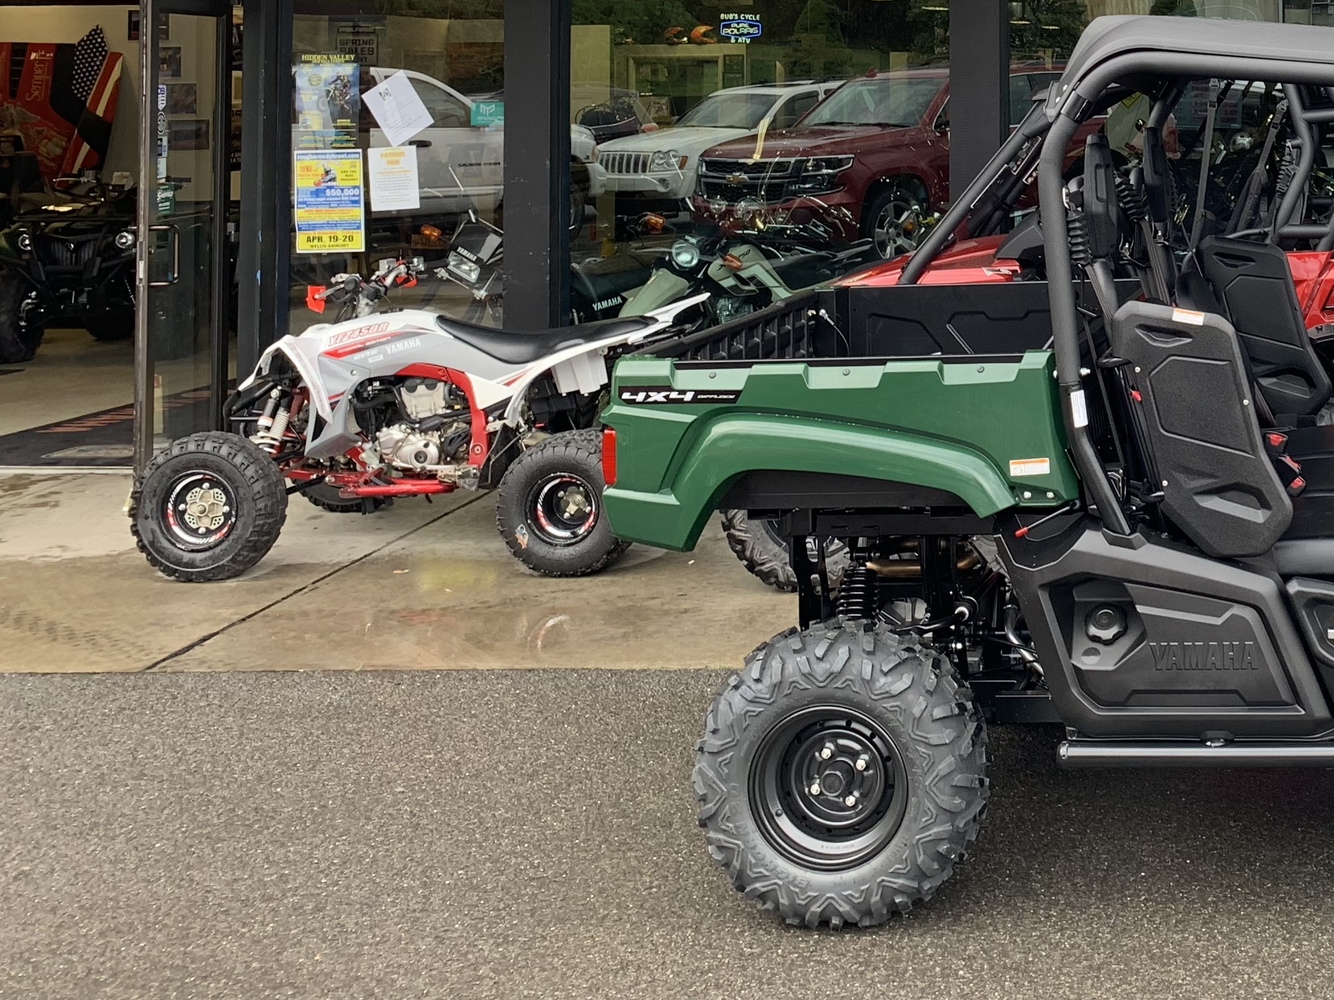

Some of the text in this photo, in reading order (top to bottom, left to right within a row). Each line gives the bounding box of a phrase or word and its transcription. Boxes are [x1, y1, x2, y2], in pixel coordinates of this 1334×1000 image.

[740, 13, 760, 21] CYCLE
[722, 27, 759, 35] POLARIS
[339, 38, 375, 46] SPRING
[325, 188, 359, 197] $50,000
[306, 234, 354, 244] APR. 19-20
[456, 246, 478, 262] YAMAHA
[592, 296, 623, 311] YAMAHA
[327, 321, 390, 347] YFZ450R
[385, 337, 422, 355] YAMAHA
[1149, 641, 1259, 671] YAMAHA
